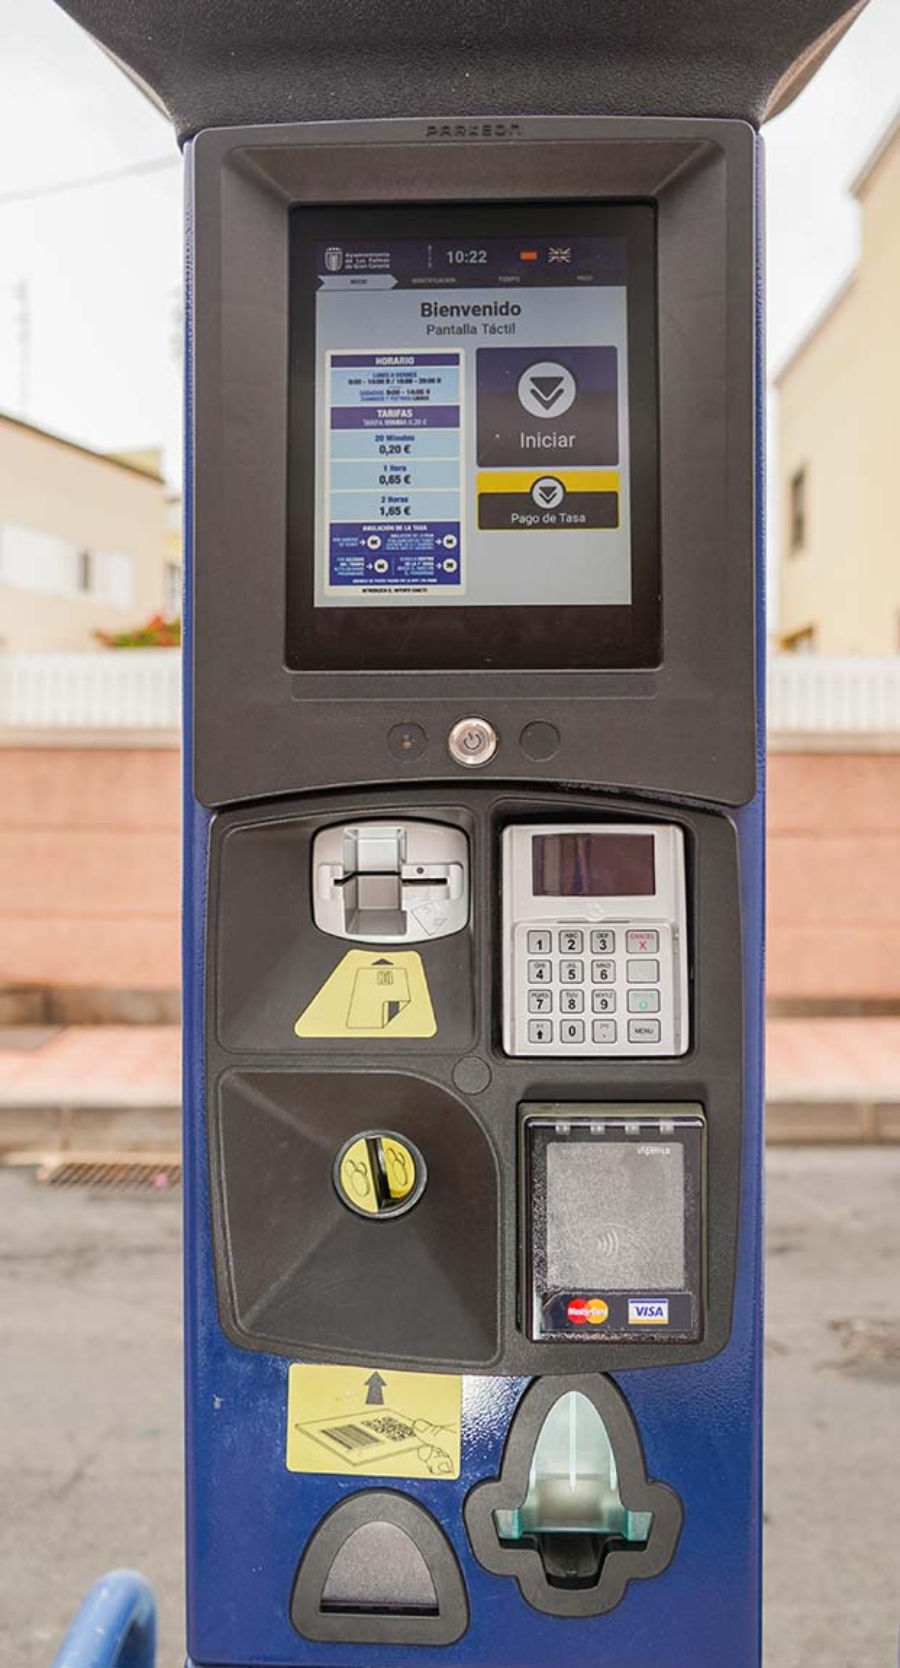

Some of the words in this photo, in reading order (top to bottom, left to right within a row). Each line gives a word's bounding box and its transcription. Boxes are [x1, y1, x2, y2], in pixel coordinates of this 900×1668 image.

[426, 125, 522, 137] PARKEON
[446, 250, 488, 264] 10:22
[420, 301, 522, 317] Bienvenido
[426, 323, 478, 336] Pantalla
[482, 322, 516, 335] Táctil
[375, 356, 415, 366] HORARIO
[376, 409, 413, 419] TARIFAS
[520, 432, 576, 449] Iniciar
[379, 445, 402, 456] 0,20
[403, 444, 411, 454] €
[379, 475, 402, 486] 0,65
[403, 474, 411, 484] €
[387, 496, 409, 504] Horas
[379, 506, 402, 517] 1,65
[403, 506, 411, 516] €
[511, 513, 540, 526] Pago
[542, 512, 557, 523] de
[558, 512, 586, 523] Tasa
[536, 939, 543, 950] 1
[567, 940, 576, 950] 2
[599, 940, 607, 950] 3
[536, 969, 544, 980] 4
[567, 969, 576, 980] 5
[600, 969, 608, 980] 6
[536, 999, 544, 1010] 7
[567, 999, 576, 1010] 8
[600, 999, 608, 1010] 9
[568, 1026, 576, 1037] 0
[635, 1306, 664, 1317] VISA
